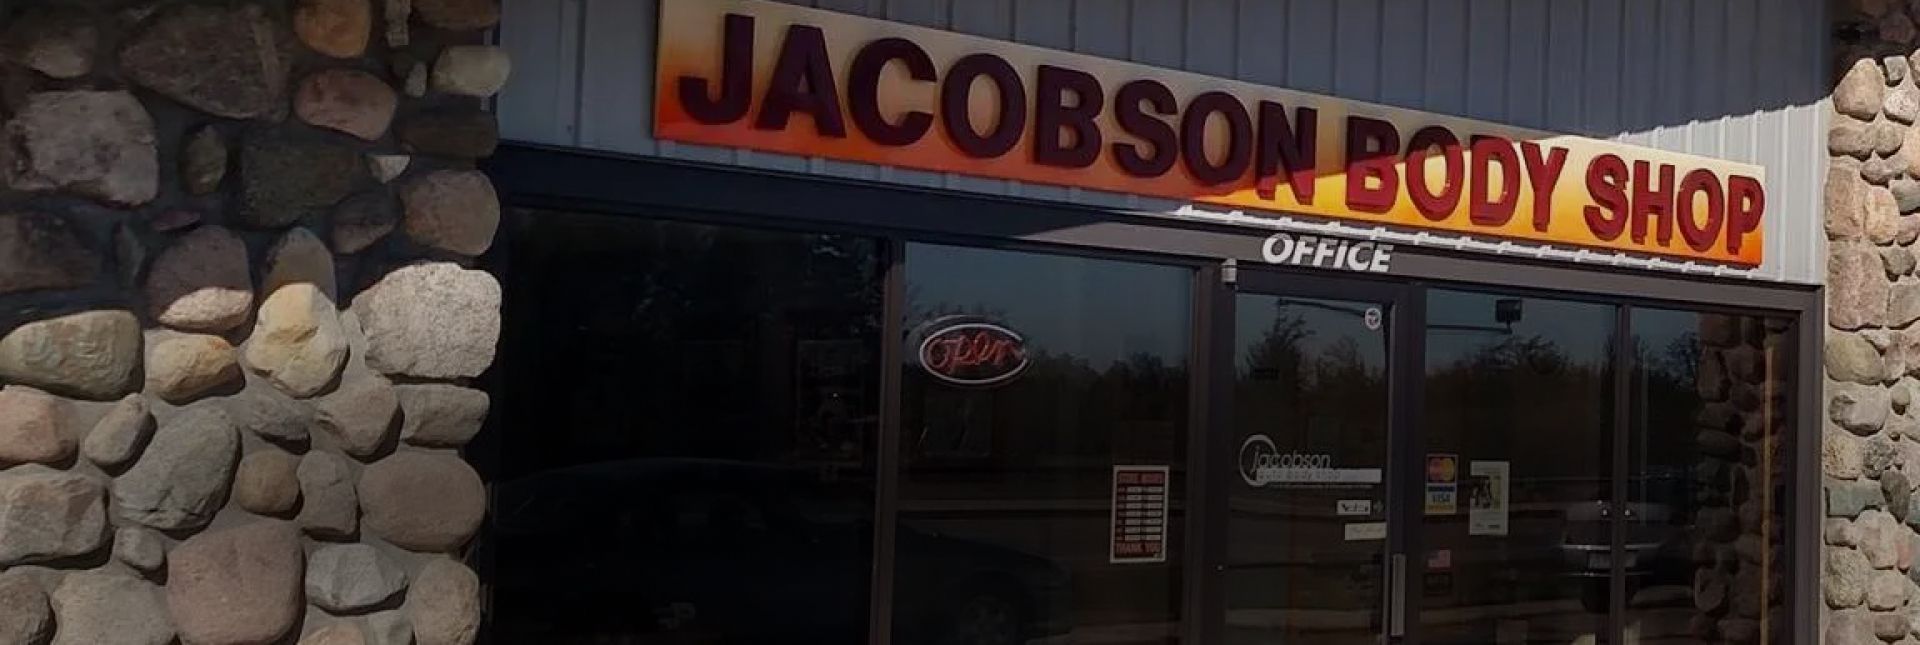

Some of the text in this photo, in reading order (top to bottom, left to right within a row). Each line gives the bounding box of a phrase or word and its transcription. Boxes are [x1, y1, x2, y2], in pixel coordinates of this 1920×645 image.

[679, 14, 1765, 253] JACOBSON BODY SHOP
[1262, 233, 1393, 272] OFFICE
